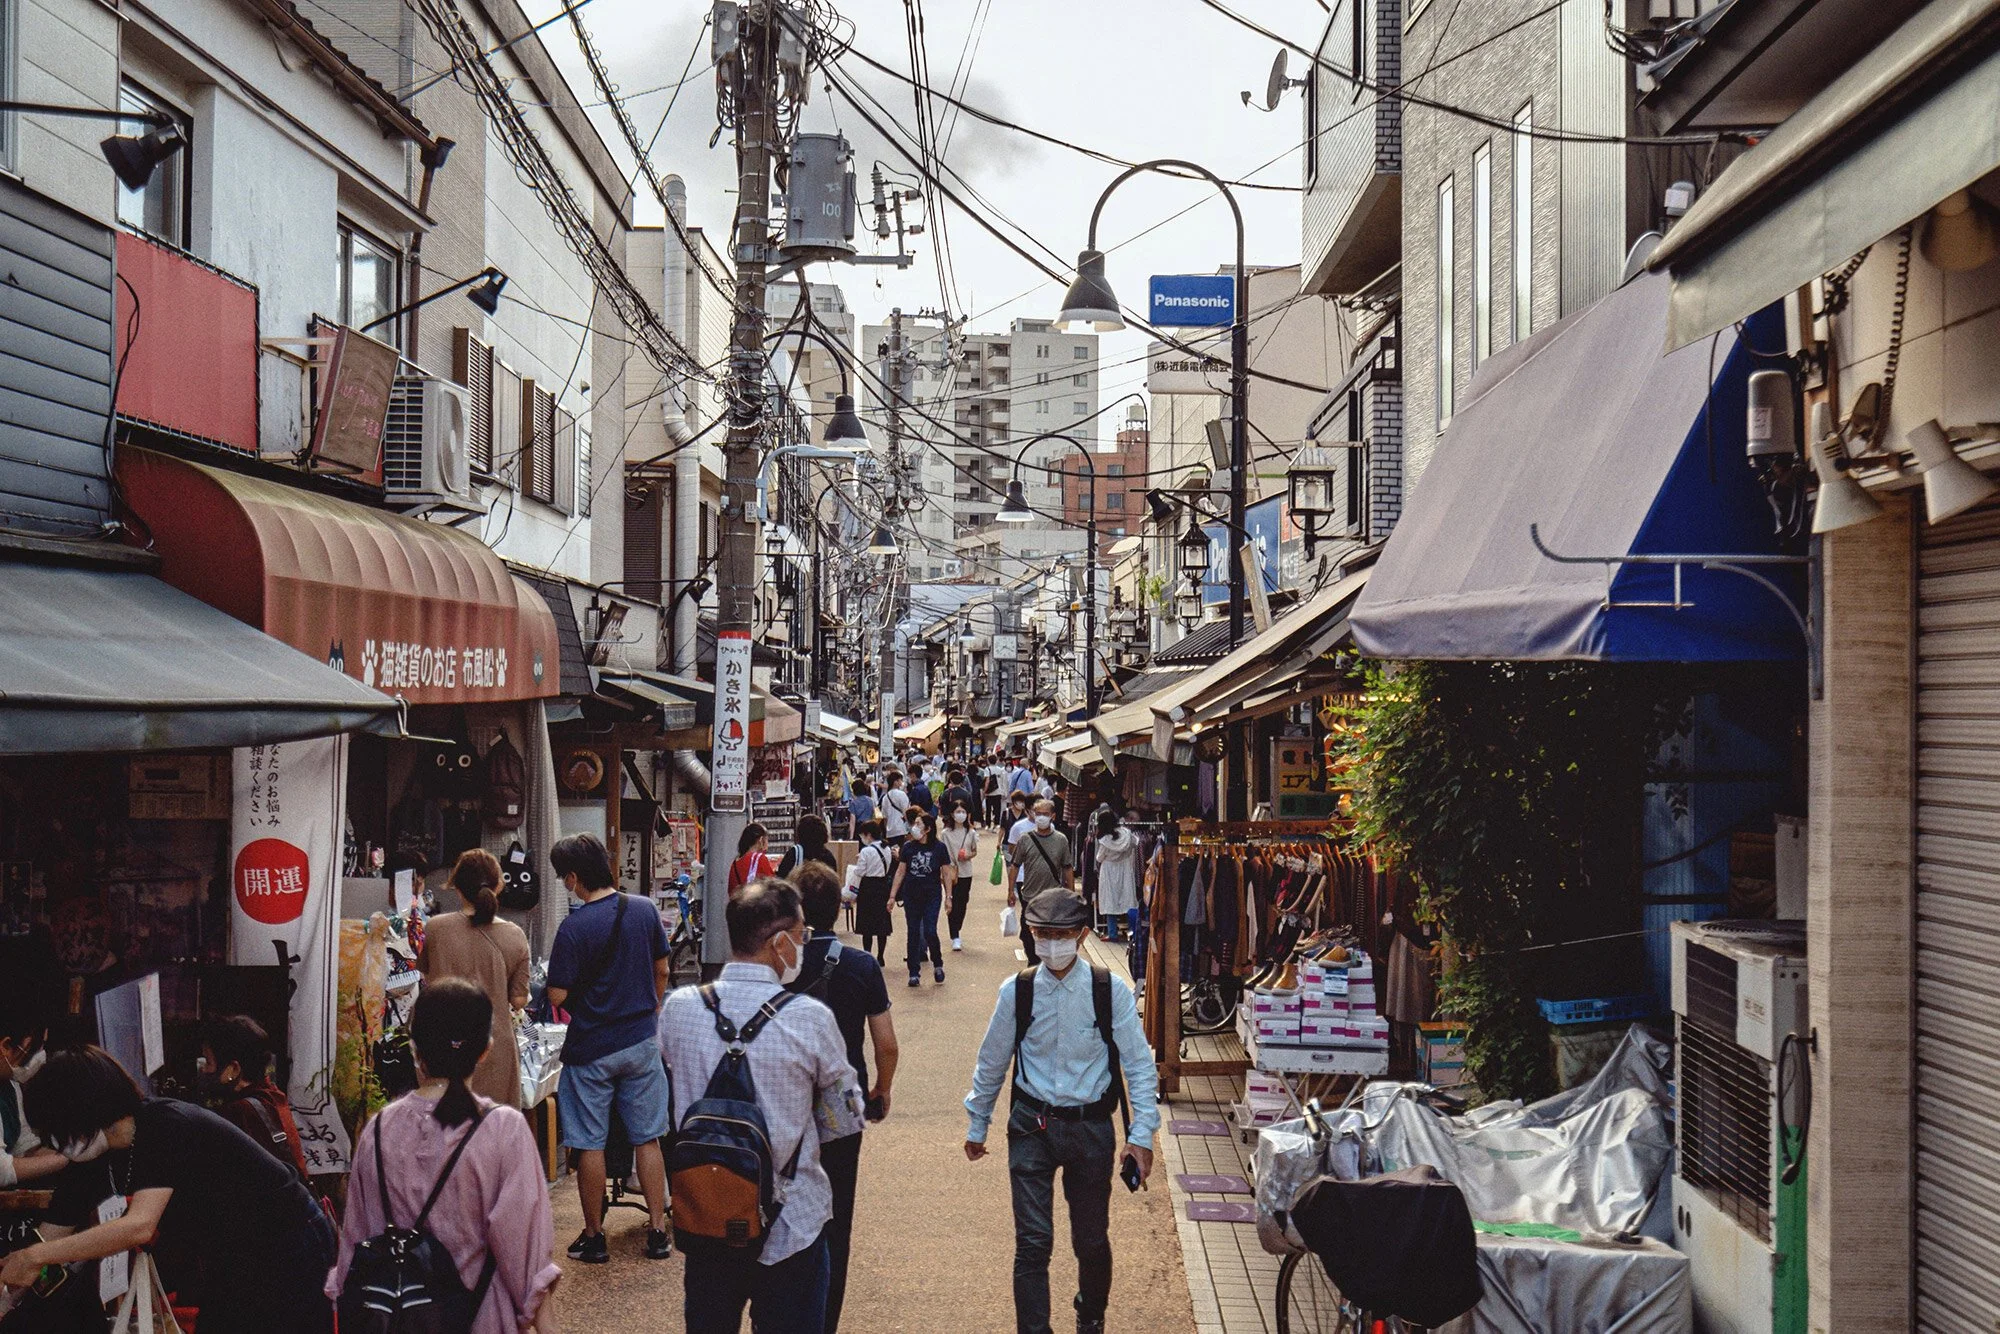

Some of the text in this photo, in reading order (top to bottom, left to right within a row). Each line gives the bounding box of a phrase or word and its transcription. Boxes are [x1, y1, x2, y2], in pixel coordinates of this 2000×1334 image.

[823, 201, 841, 217] 100
[1154, 294, 1230, 308] Panasonic
[380, 641, 494, 688] 猫雑貨のお店 布風船
[724, 660, 742, 714] かき氷
[243, 866, 304, 896] 開運
